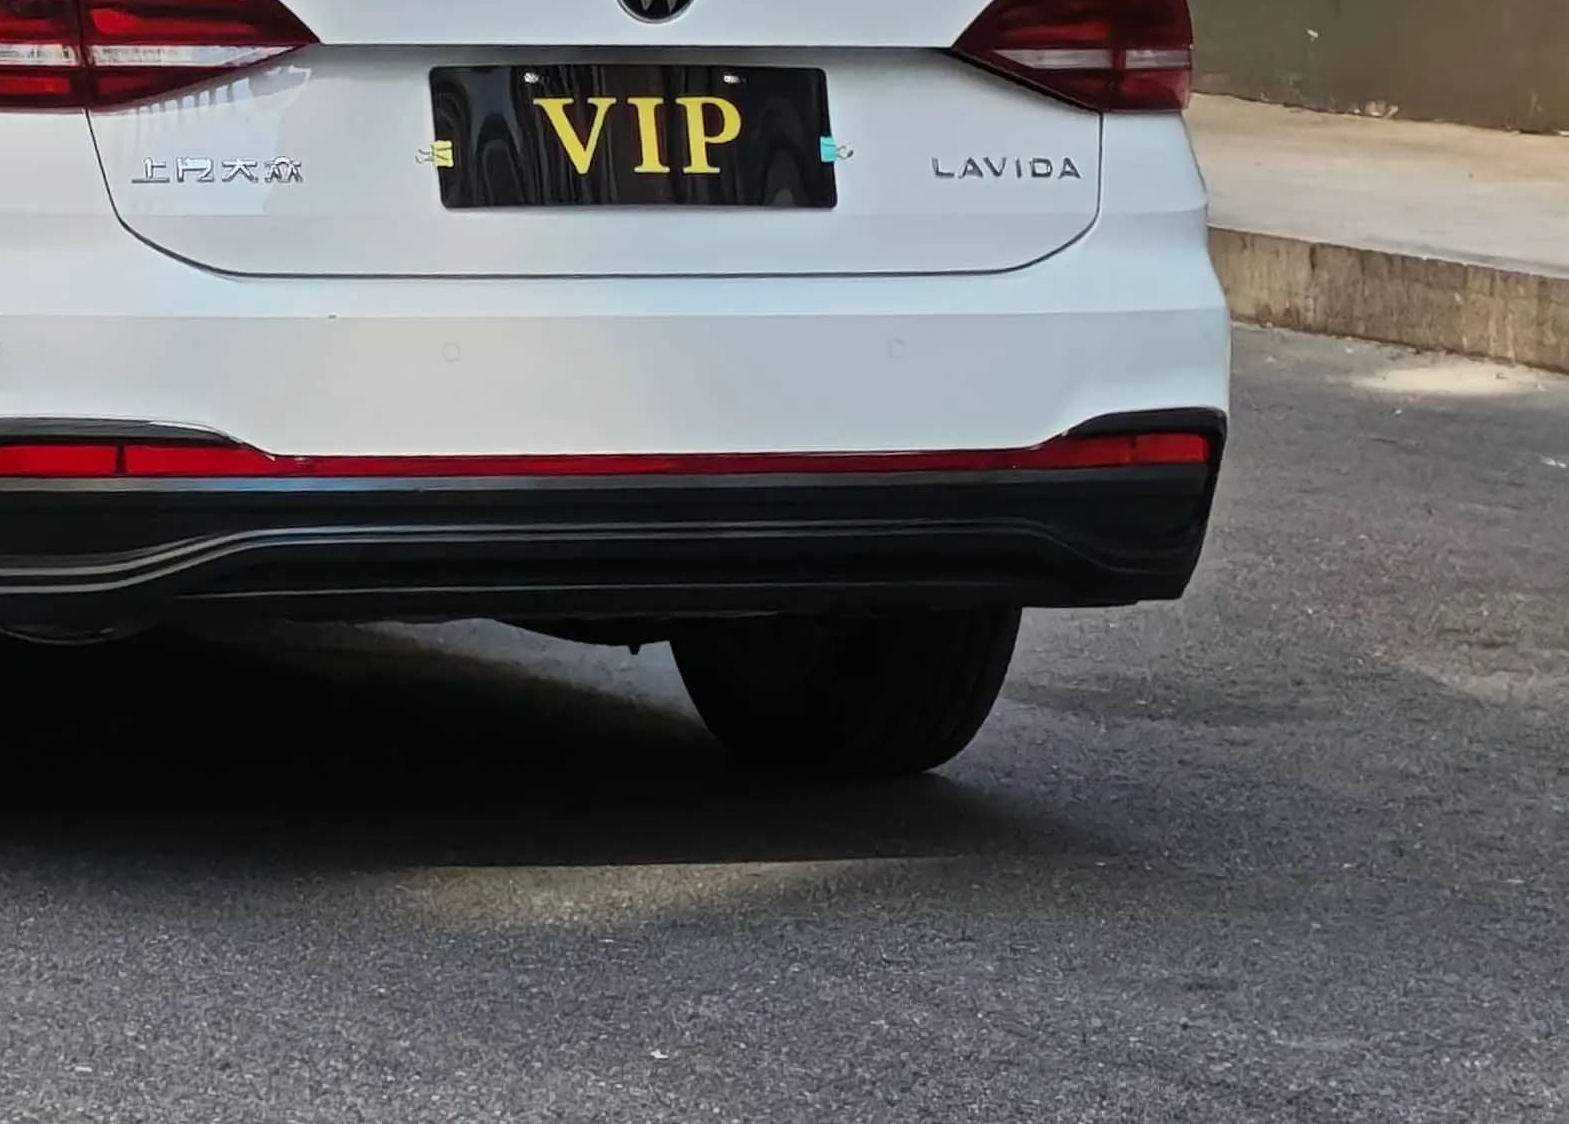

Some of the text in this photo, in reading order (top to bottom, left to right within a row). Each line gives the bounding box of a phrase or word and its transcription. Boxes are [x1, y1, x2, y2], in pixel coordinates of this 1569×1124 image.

[533, 96, 741, 174] VIP
[130, 155, 304, 184] 上汽大众
[931, 156, 1082, 180] LAVIDA
